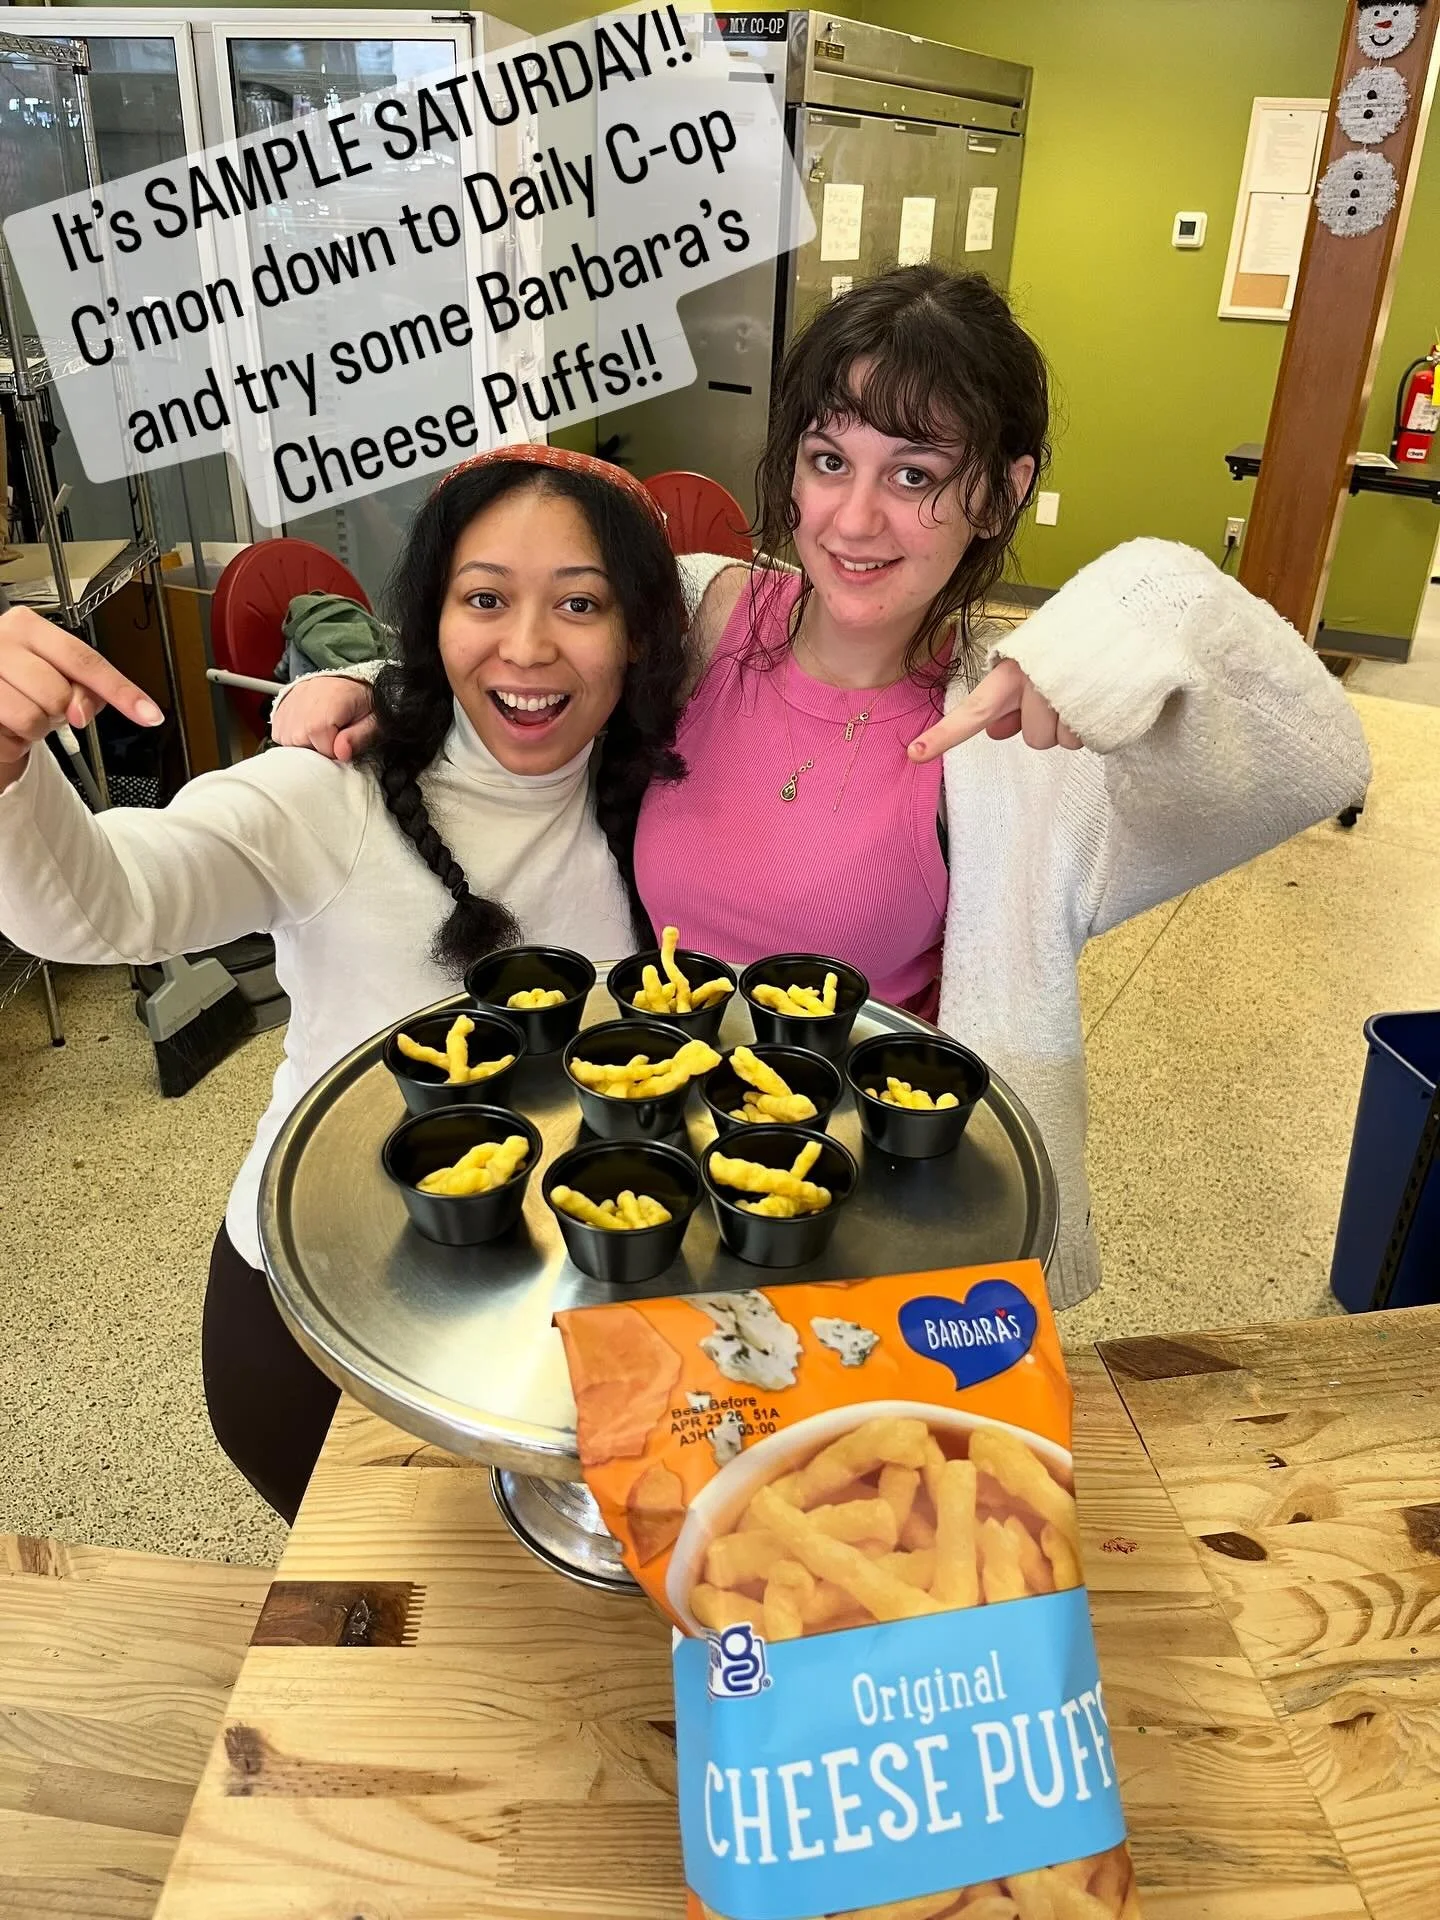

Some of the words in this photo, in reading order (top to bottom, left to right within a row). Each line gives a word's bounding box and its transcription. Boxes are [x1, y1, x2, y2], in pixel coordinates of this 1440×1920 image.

[707, 17, 713, 33] I
[729, 17, 748, 34] MY
[750, 17, 785, 34] CO-OP
[671, 1403, 706, 1420] Best
[709, 1395, 758, 1411] Before
[671, 1416, 702, 1435] APR
[706, 1412, 723, 1426] 23
[727, 1409, 745, 1422] 26
[753, 1407, 781, 1421] 51A
[738, 1421, 777, 1437] 03:00
[852, 1650, 1008, 1727] Original
[704, 1733, 963, 1865] CHEESE
